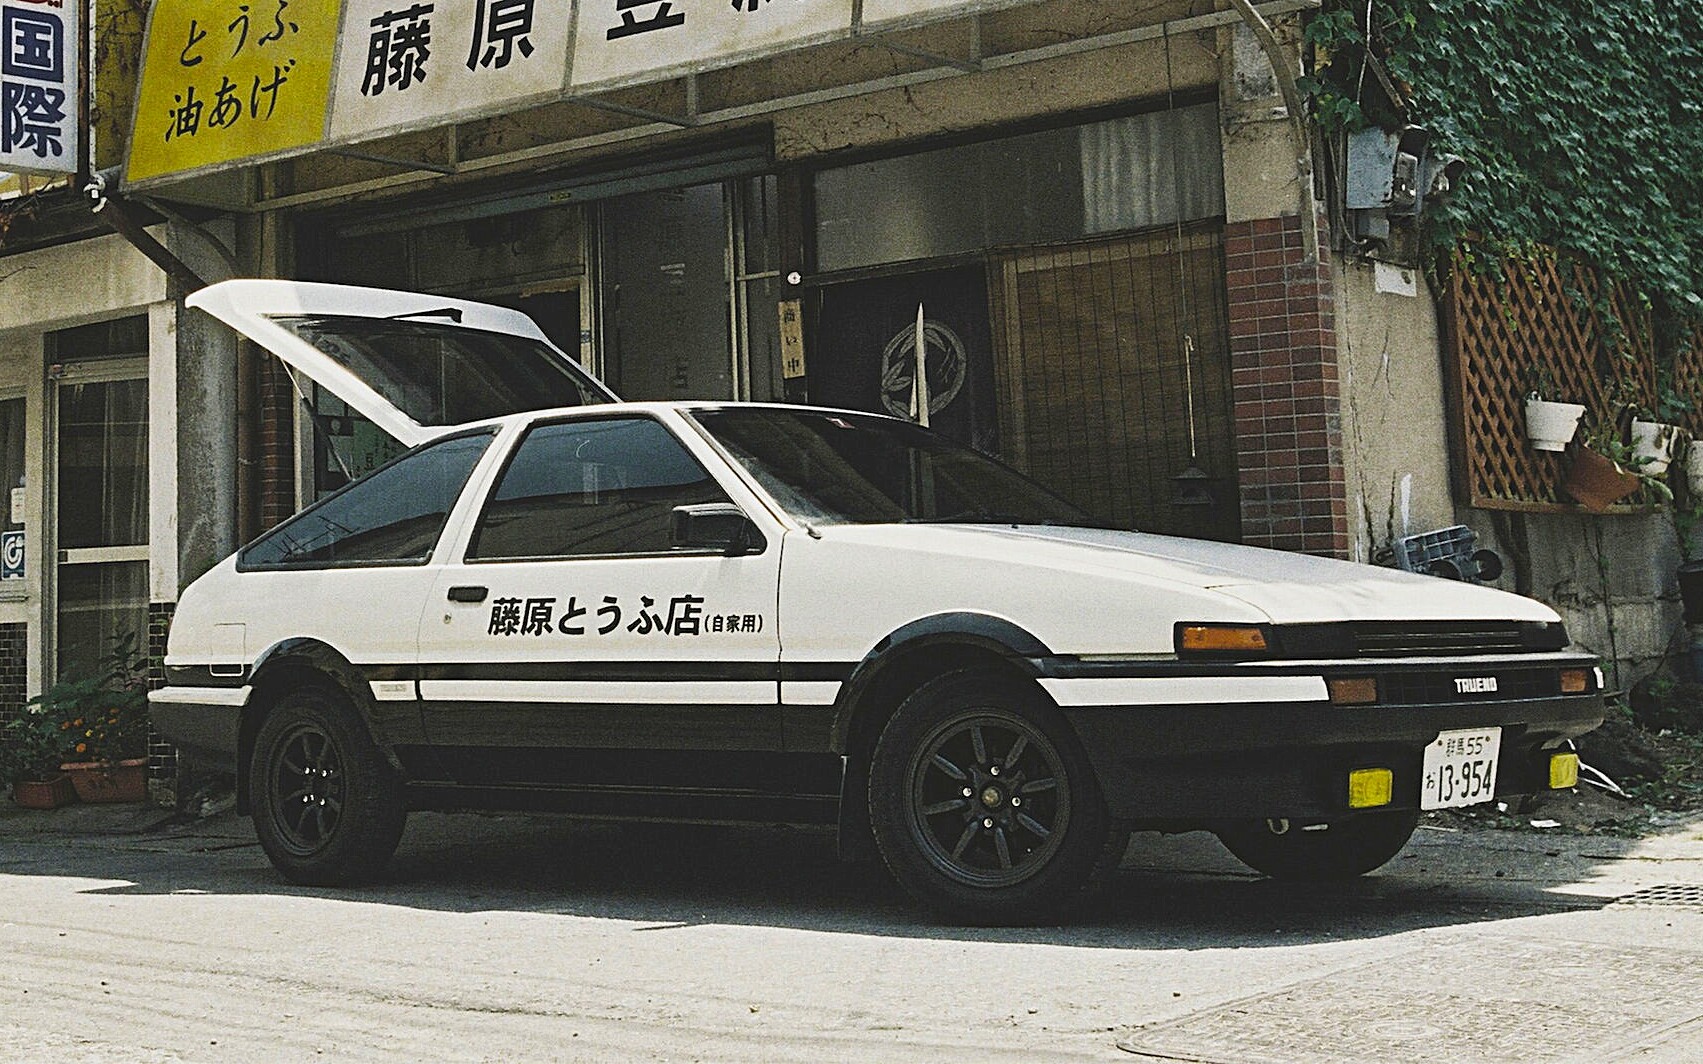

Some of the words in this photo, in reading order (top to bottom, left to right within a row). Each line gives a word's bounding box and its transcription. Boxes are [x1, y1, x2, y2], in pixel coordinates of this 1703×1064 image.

[180, 0, 299, 67] とうふ
[2, 5, 66, 158] 国際
[165, 59, 296, 142] 油あげ
[1454, 677, 1498, 693] TRUENO
